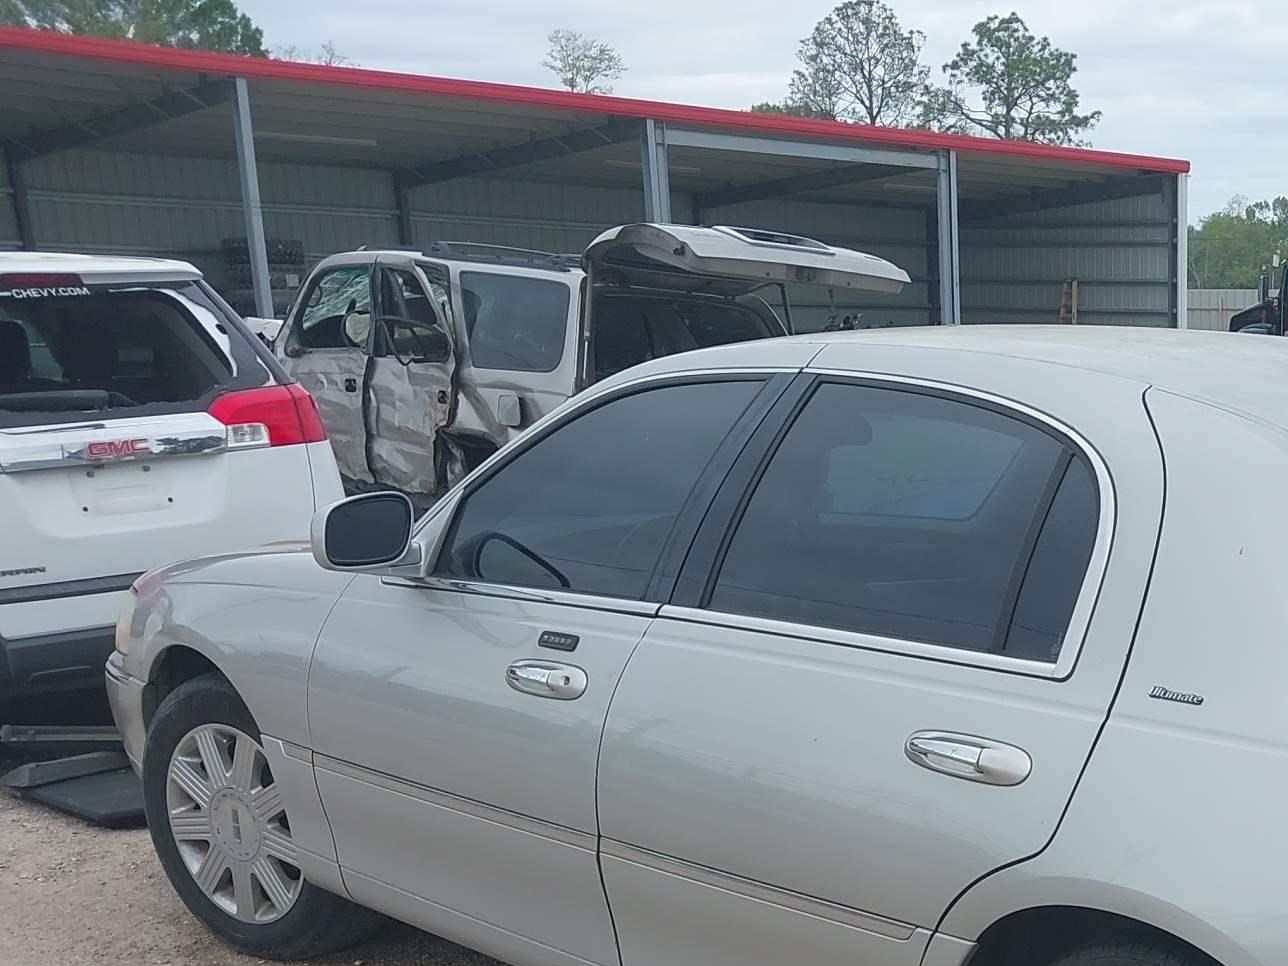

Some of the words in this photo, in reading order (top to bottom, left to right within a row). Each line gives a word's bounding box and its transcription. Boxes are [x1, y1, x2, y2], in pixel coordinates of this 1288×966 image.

[11, 287, 91, 299] CHEVY.COM
[87, 438, 150, 459] GMC
[1148, 686, 1204, 706] Ultimate
